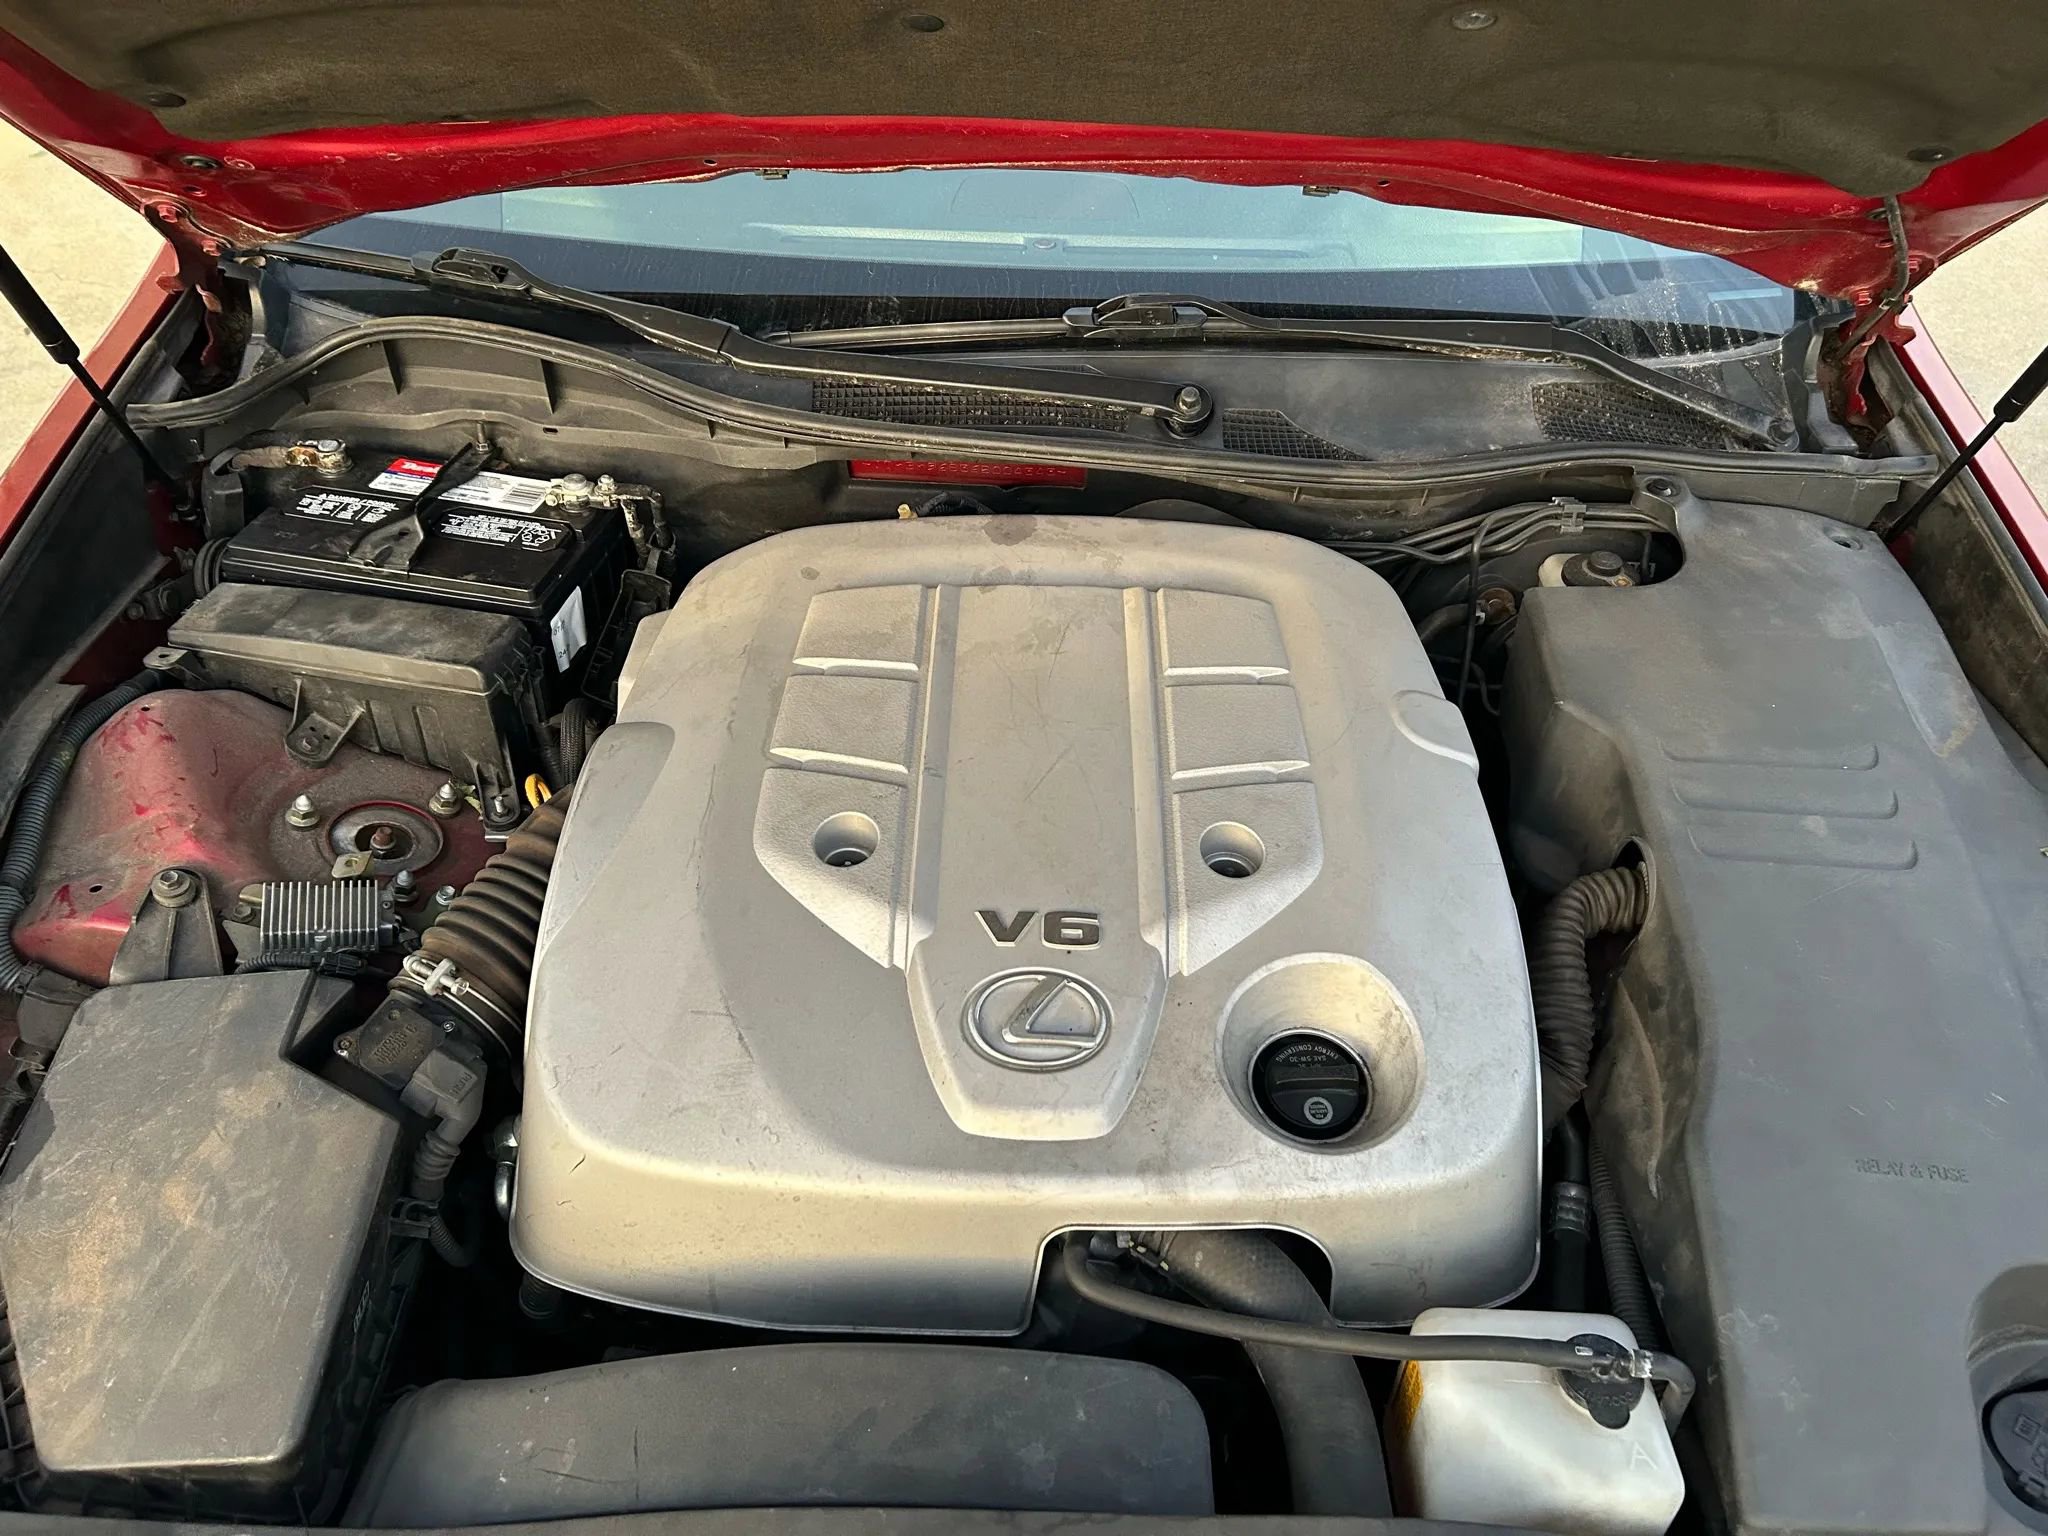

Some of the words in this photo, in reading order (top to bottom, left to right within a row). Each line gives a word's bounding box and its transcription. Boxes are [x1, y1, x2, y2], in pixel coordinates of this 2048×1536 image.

[974, 910, 1101, 950] V6
[1275, 1044, 1312, 1063] CONSERVING
[1289, 1055, 1312, 1063] 5W-30
[1313, 1045, 1339, 1060] ENERGY
[1313, 1055, 1327, 1063] SAE
[1855, 1157, 1904, 1178] RELAY
[1928, 1164, 1969, 1184] FUSE
